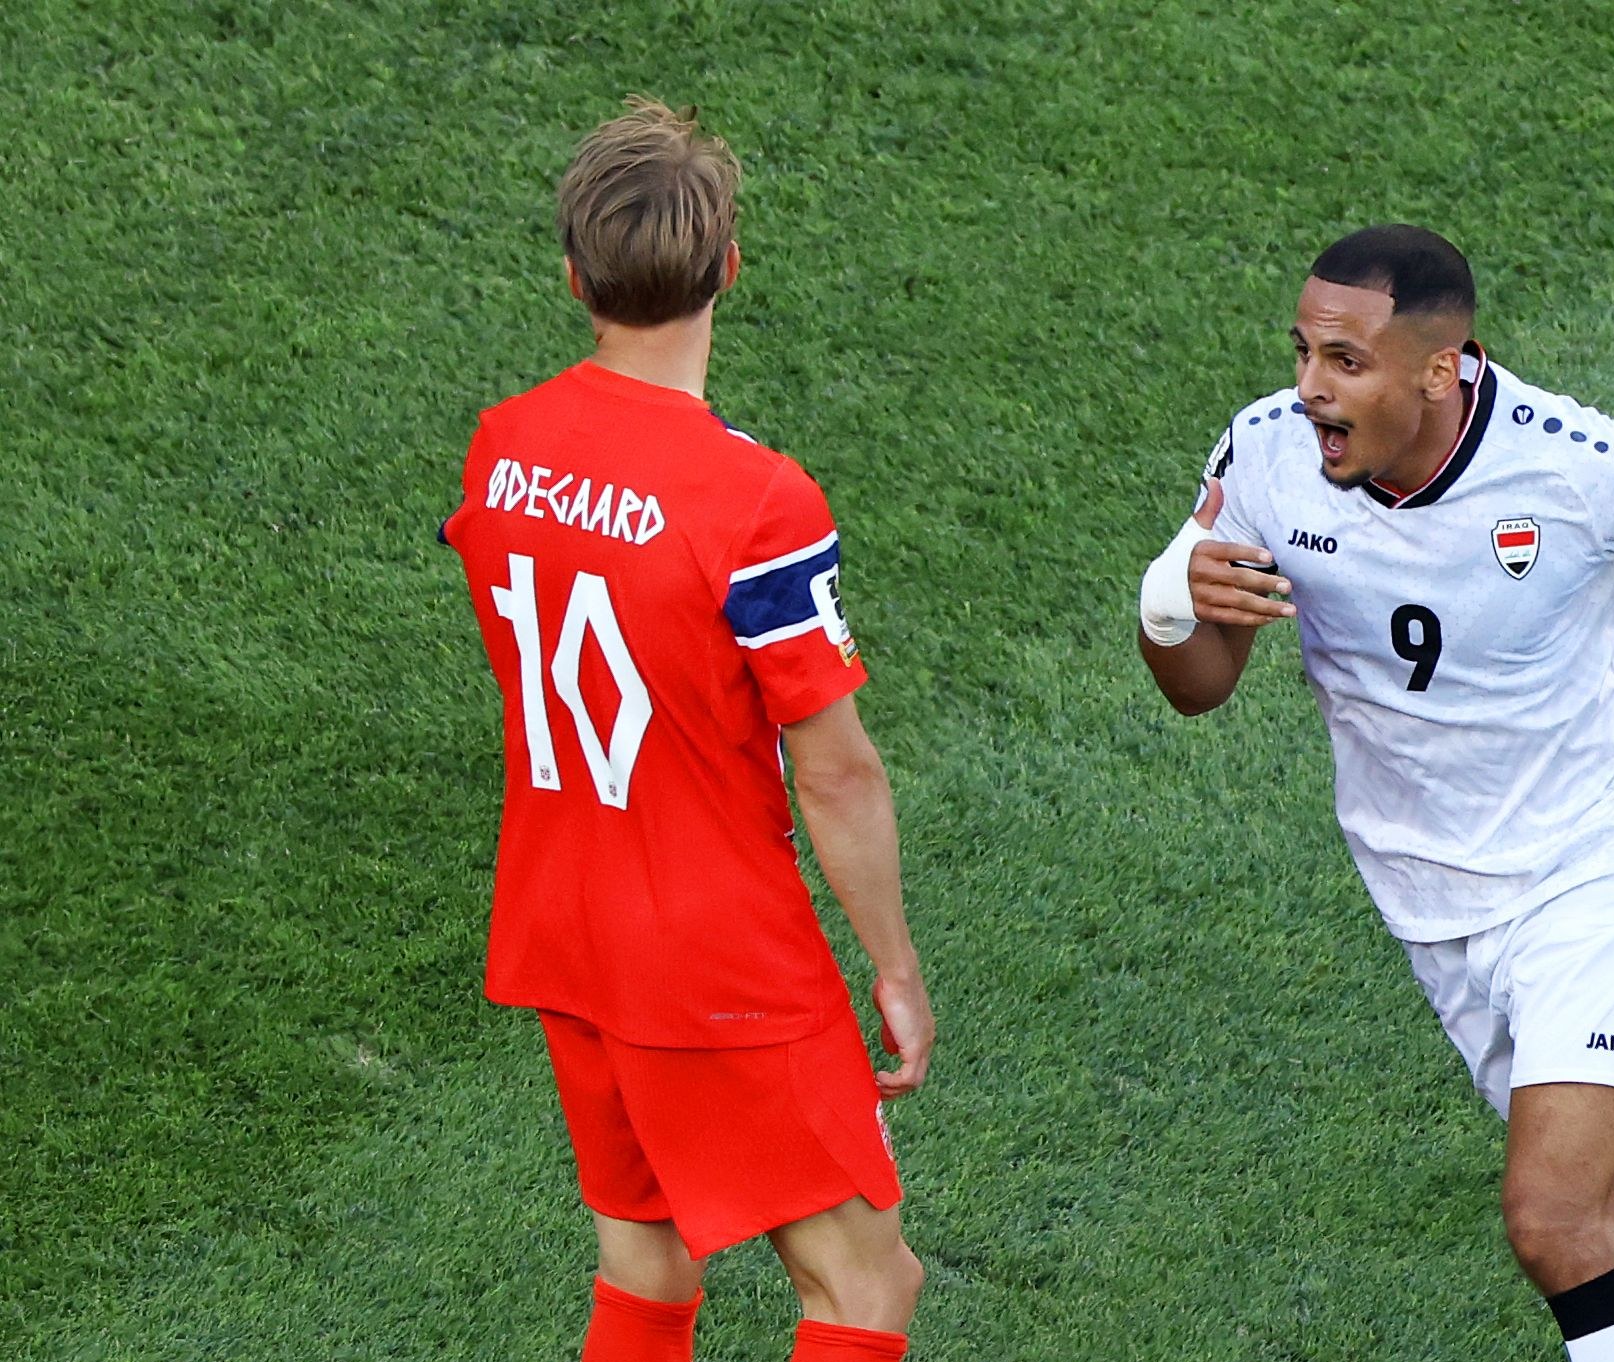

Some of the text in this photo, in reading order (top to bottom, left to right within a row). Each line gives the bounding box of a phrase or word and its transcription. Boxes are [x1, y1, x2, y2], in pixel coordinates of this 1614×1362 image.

[486, 458, 665, 545] ØDEGAARD
[1287, 528, 1338, 554] JAKO
[1502, 522, 1529, 530] IRAQ
[490, 552, 653, 811] 10
[1390, 604, 1443, 692] 9
